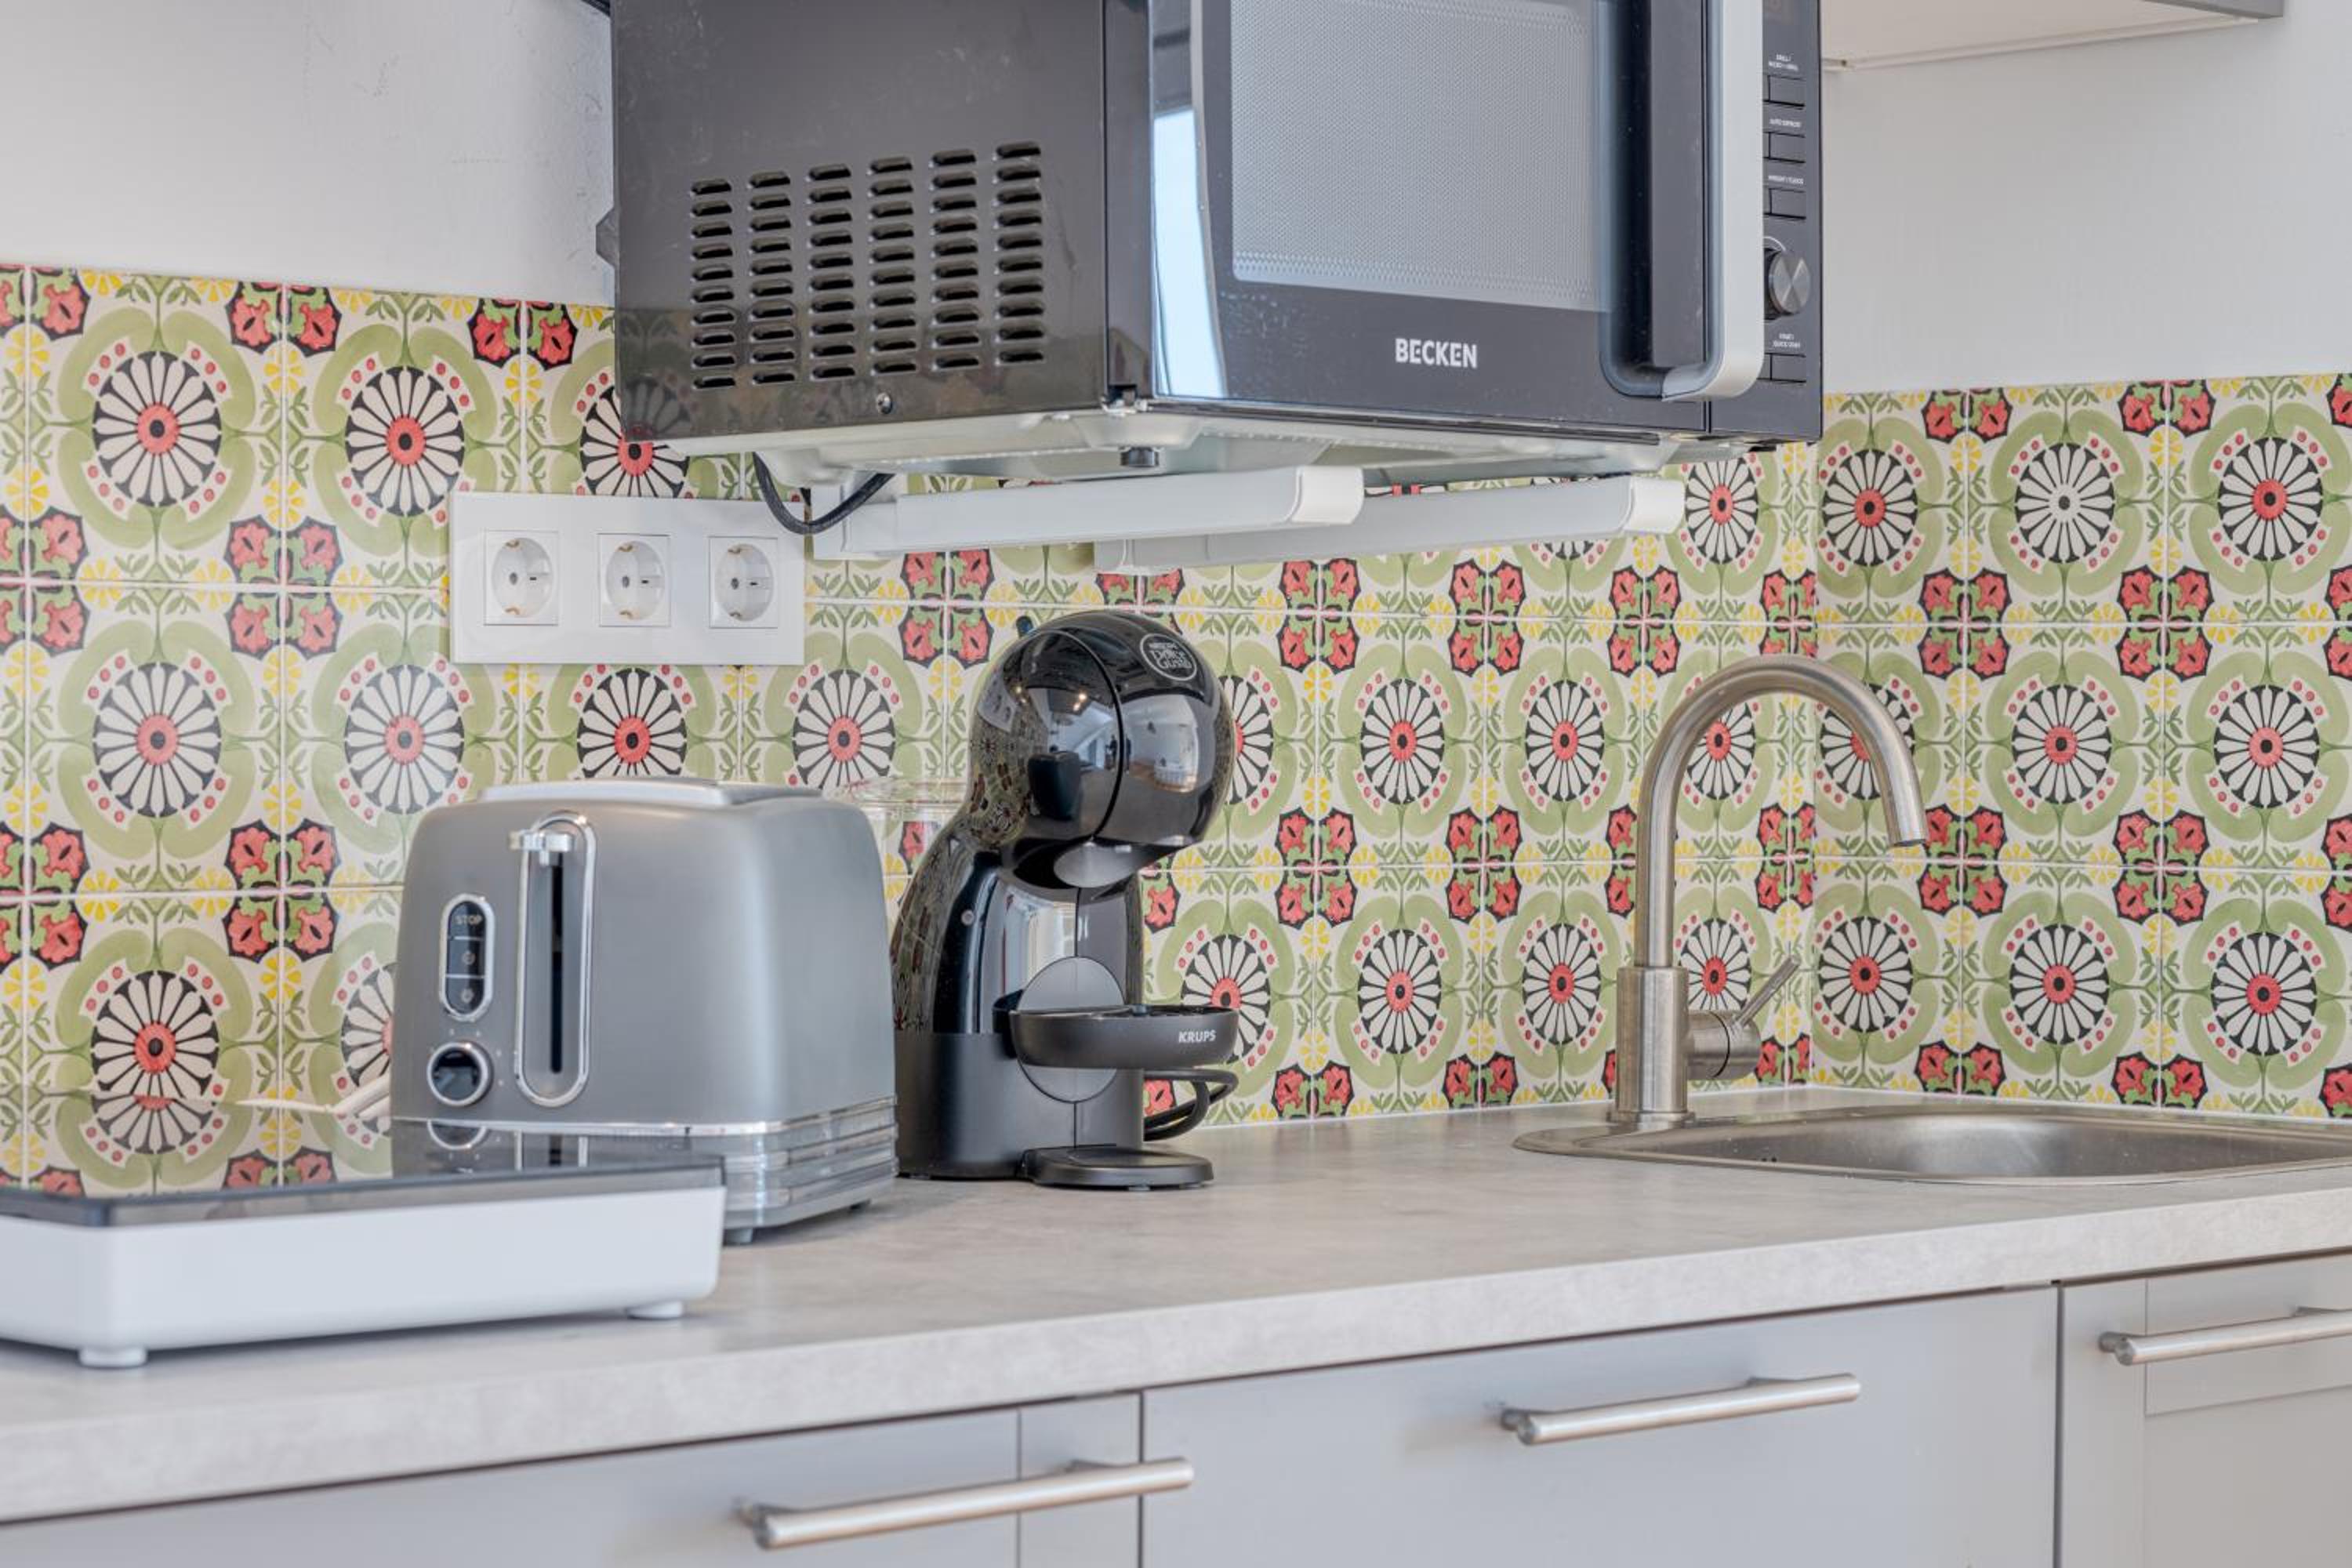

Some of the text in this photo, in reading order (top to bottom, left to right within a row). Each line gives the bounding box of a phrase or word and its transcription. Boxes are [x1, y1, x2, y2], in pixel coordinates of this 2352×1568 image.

[1396, 338, 1477, 368] BECKEN
[455, 915, 483, 924] STOP
[1178, 1029, 1217, 1044] KRUPS
